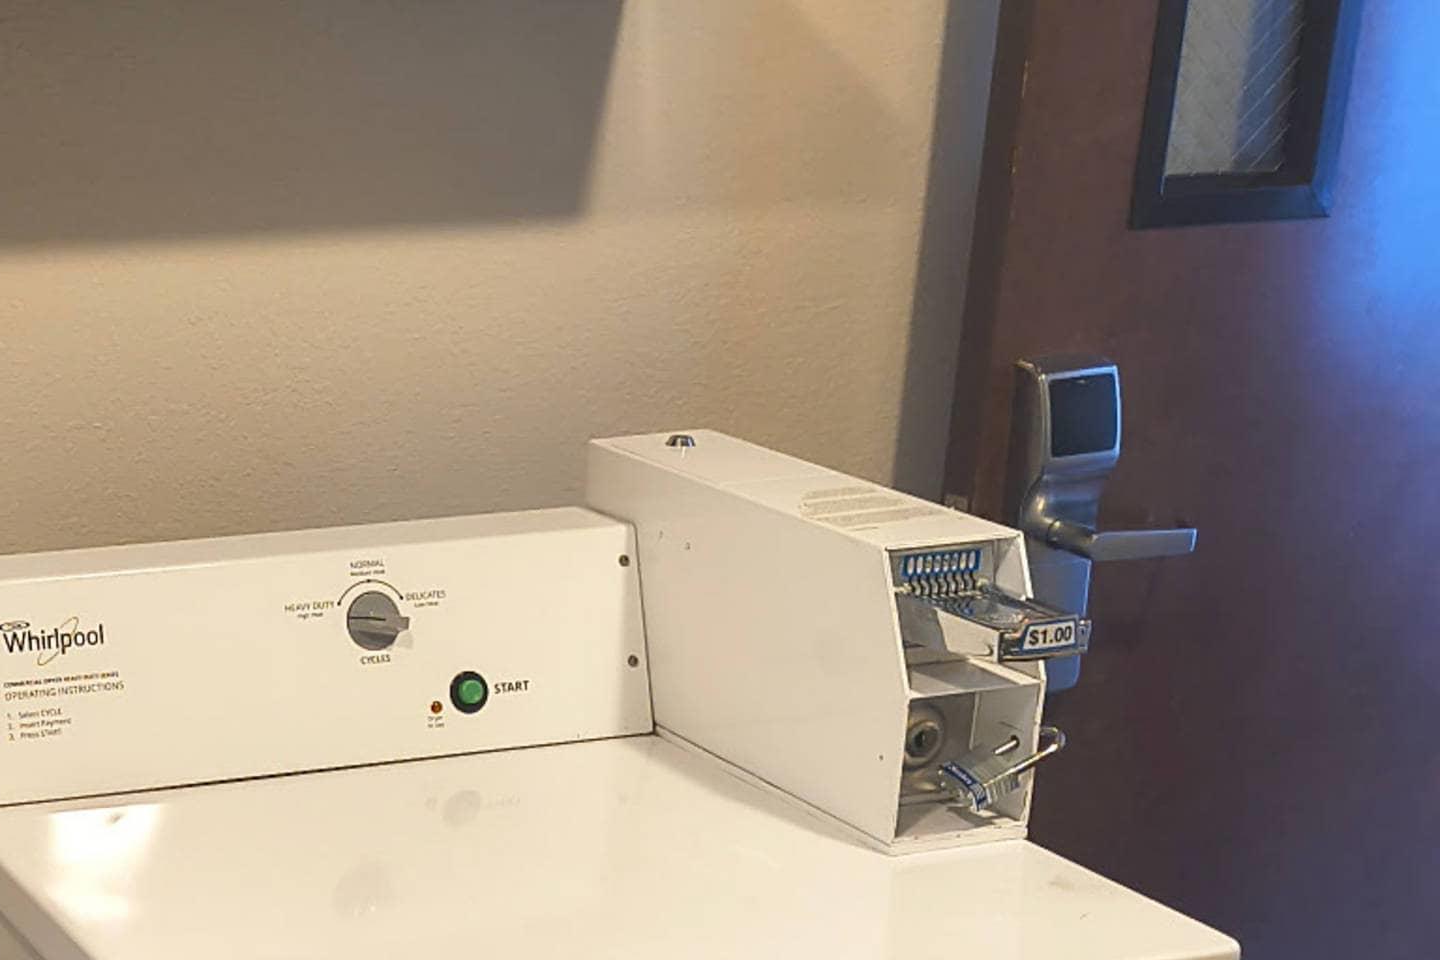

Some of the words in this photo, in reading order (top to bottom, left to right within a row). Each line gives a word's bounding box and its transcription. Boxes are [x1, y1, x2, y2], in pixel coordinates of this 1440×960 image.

[350, 559, 385, 569] NORMAL
[405, 590, 447, 601] DELICATES
[284, 603, 311, 613] HEAVY
[312, 600, 335, 610] DUTY
[3, 623, 105, 655] Whirlpool
[1028, 624, 1074, 646] $1.00
[360, 654, 391, 666] CYCLES
[5, 687, 57, 701] OPERATING
[58, 681, 125, 696] INSTRUCTIONS
[494, 680, 530, 694] START
[41, 708, 62, 717] CYCLE
[41, 718, 72, 728] Payment
